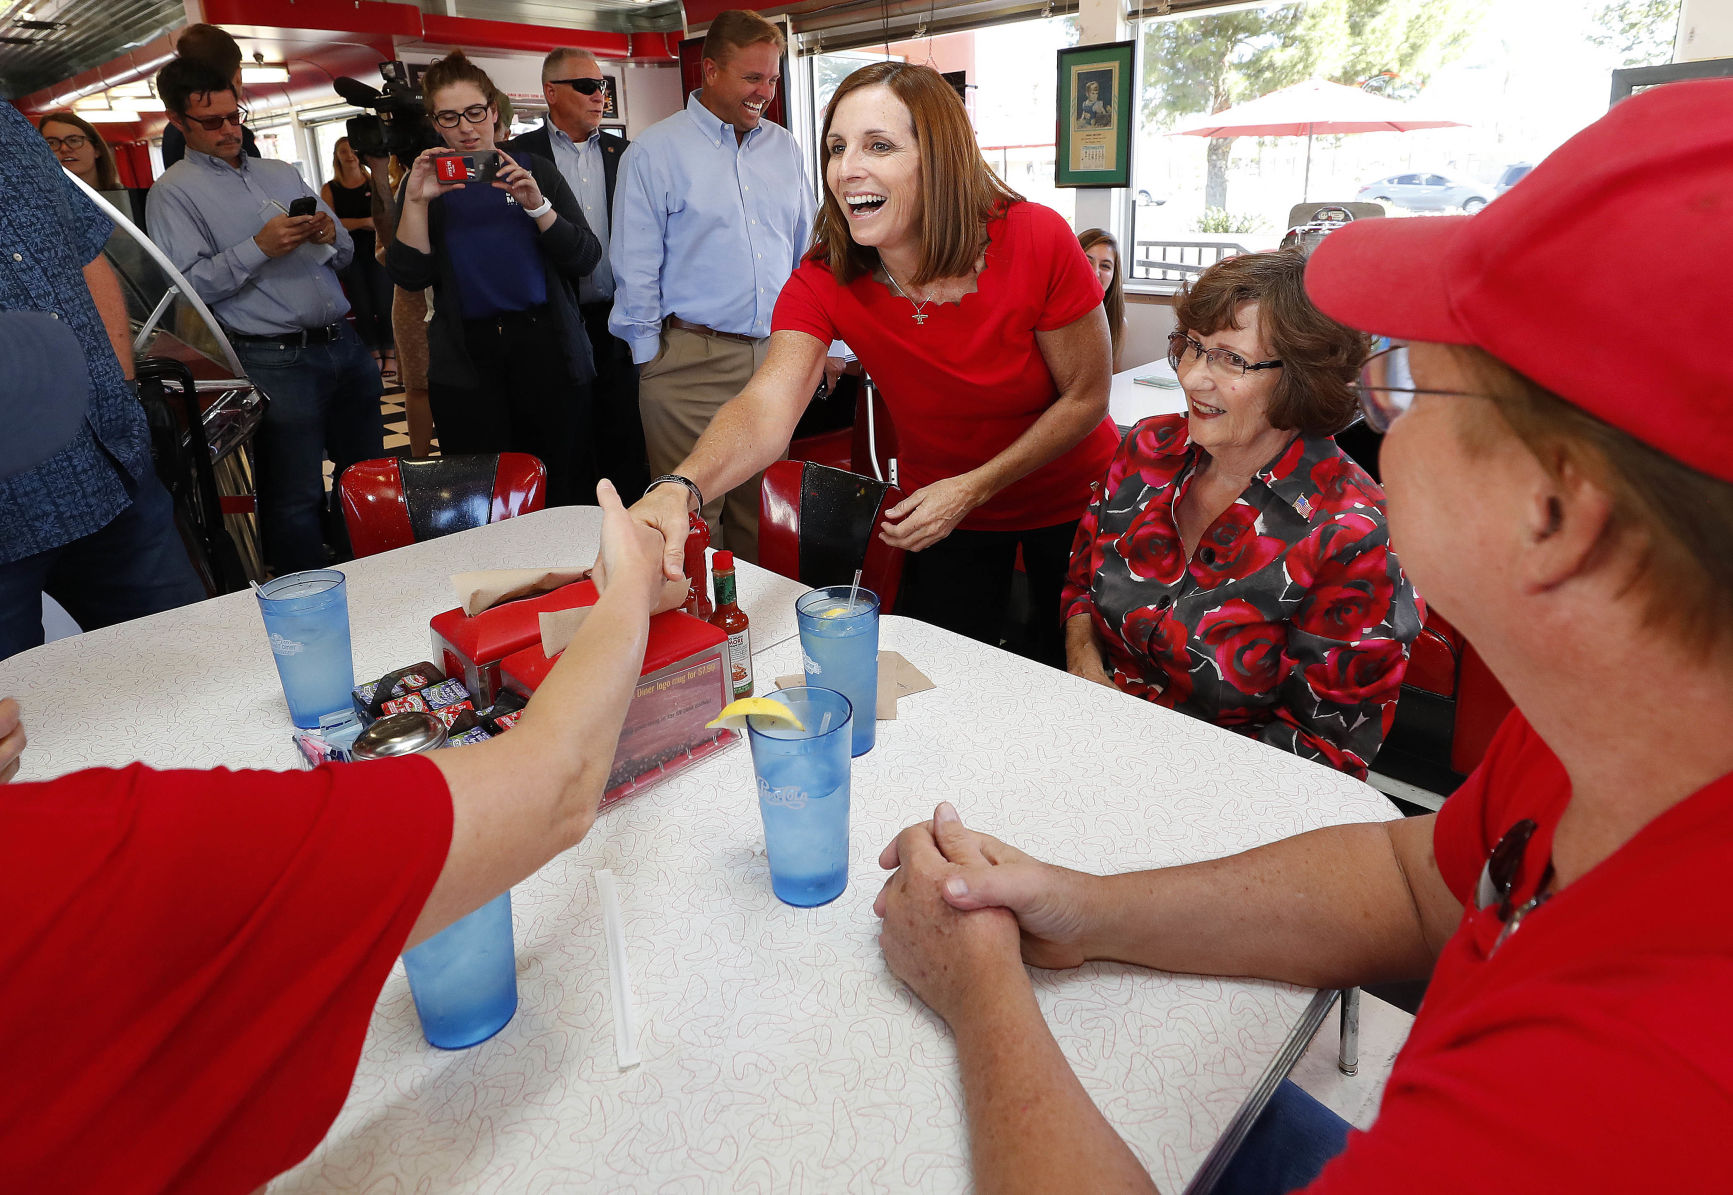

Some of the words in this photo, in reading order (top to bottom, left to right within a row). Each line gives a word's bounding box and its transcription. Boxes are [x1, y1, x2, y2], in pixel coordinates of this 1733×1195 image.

[637, 685, 655, 697] Diner
[656, 680, 671, 690] logo
[672, 675, 686, 685] mug
[687, 670, 696, 679] for
